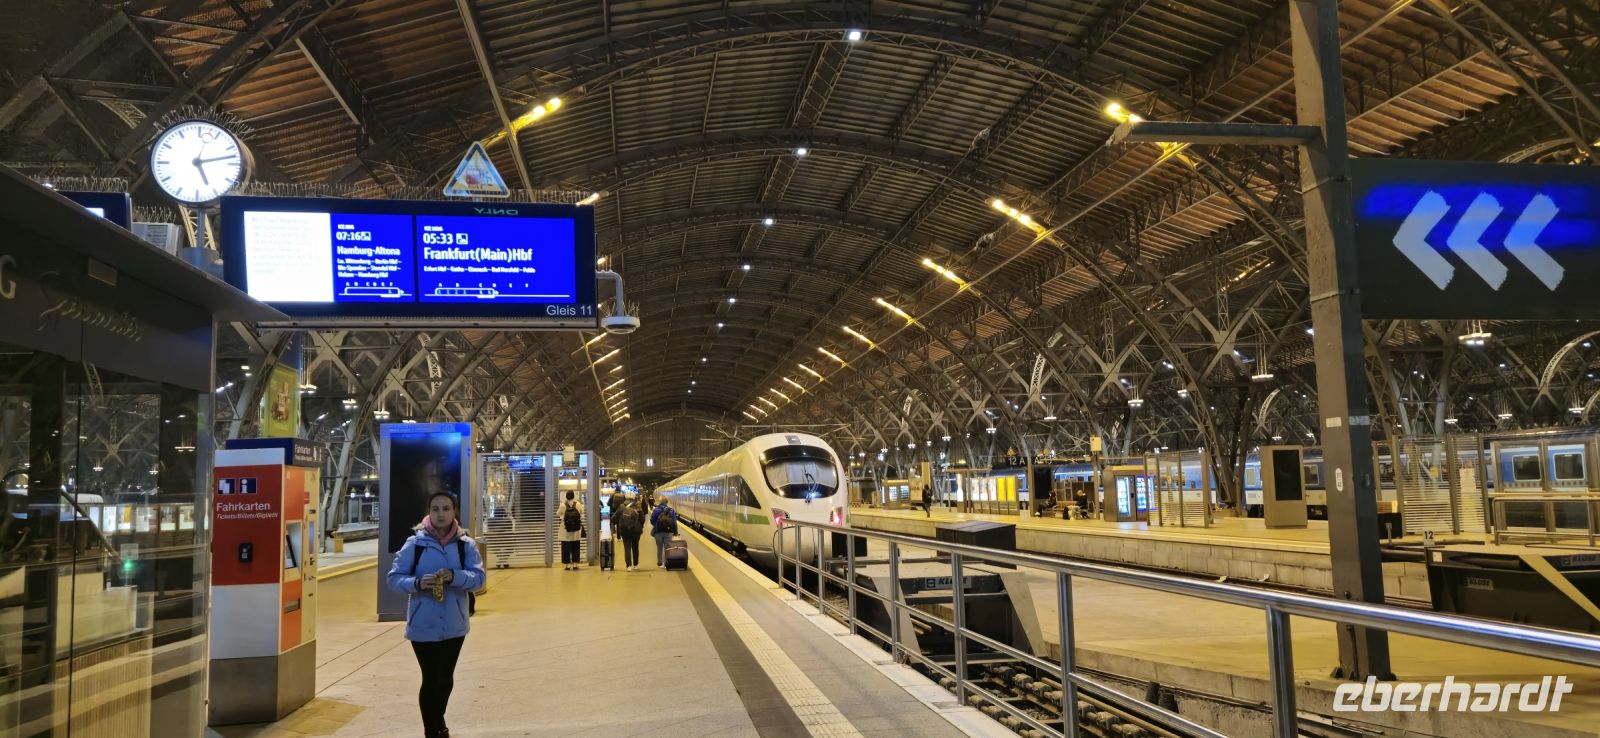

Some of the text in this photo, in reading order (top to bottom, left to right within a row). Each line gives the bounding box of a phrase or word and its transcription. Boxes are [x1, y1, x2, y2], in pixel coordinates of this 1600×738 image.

[336, 231, 361, 241] 07:16
[423, 233, 453, 245] 05:33
[337, 246, 401, 257] Hamburg-Altona
[424, 247, 533, 263] Frankfurt(Main)Hbf
[546, 304, 592, 316] Gleis 11
[1009, 457, 1017, 465] 12
[1020, 457, 1026, 465] A
[216, 502, 271, 512] Fahrkarten
[1424, 530, 1434, 540] 12
